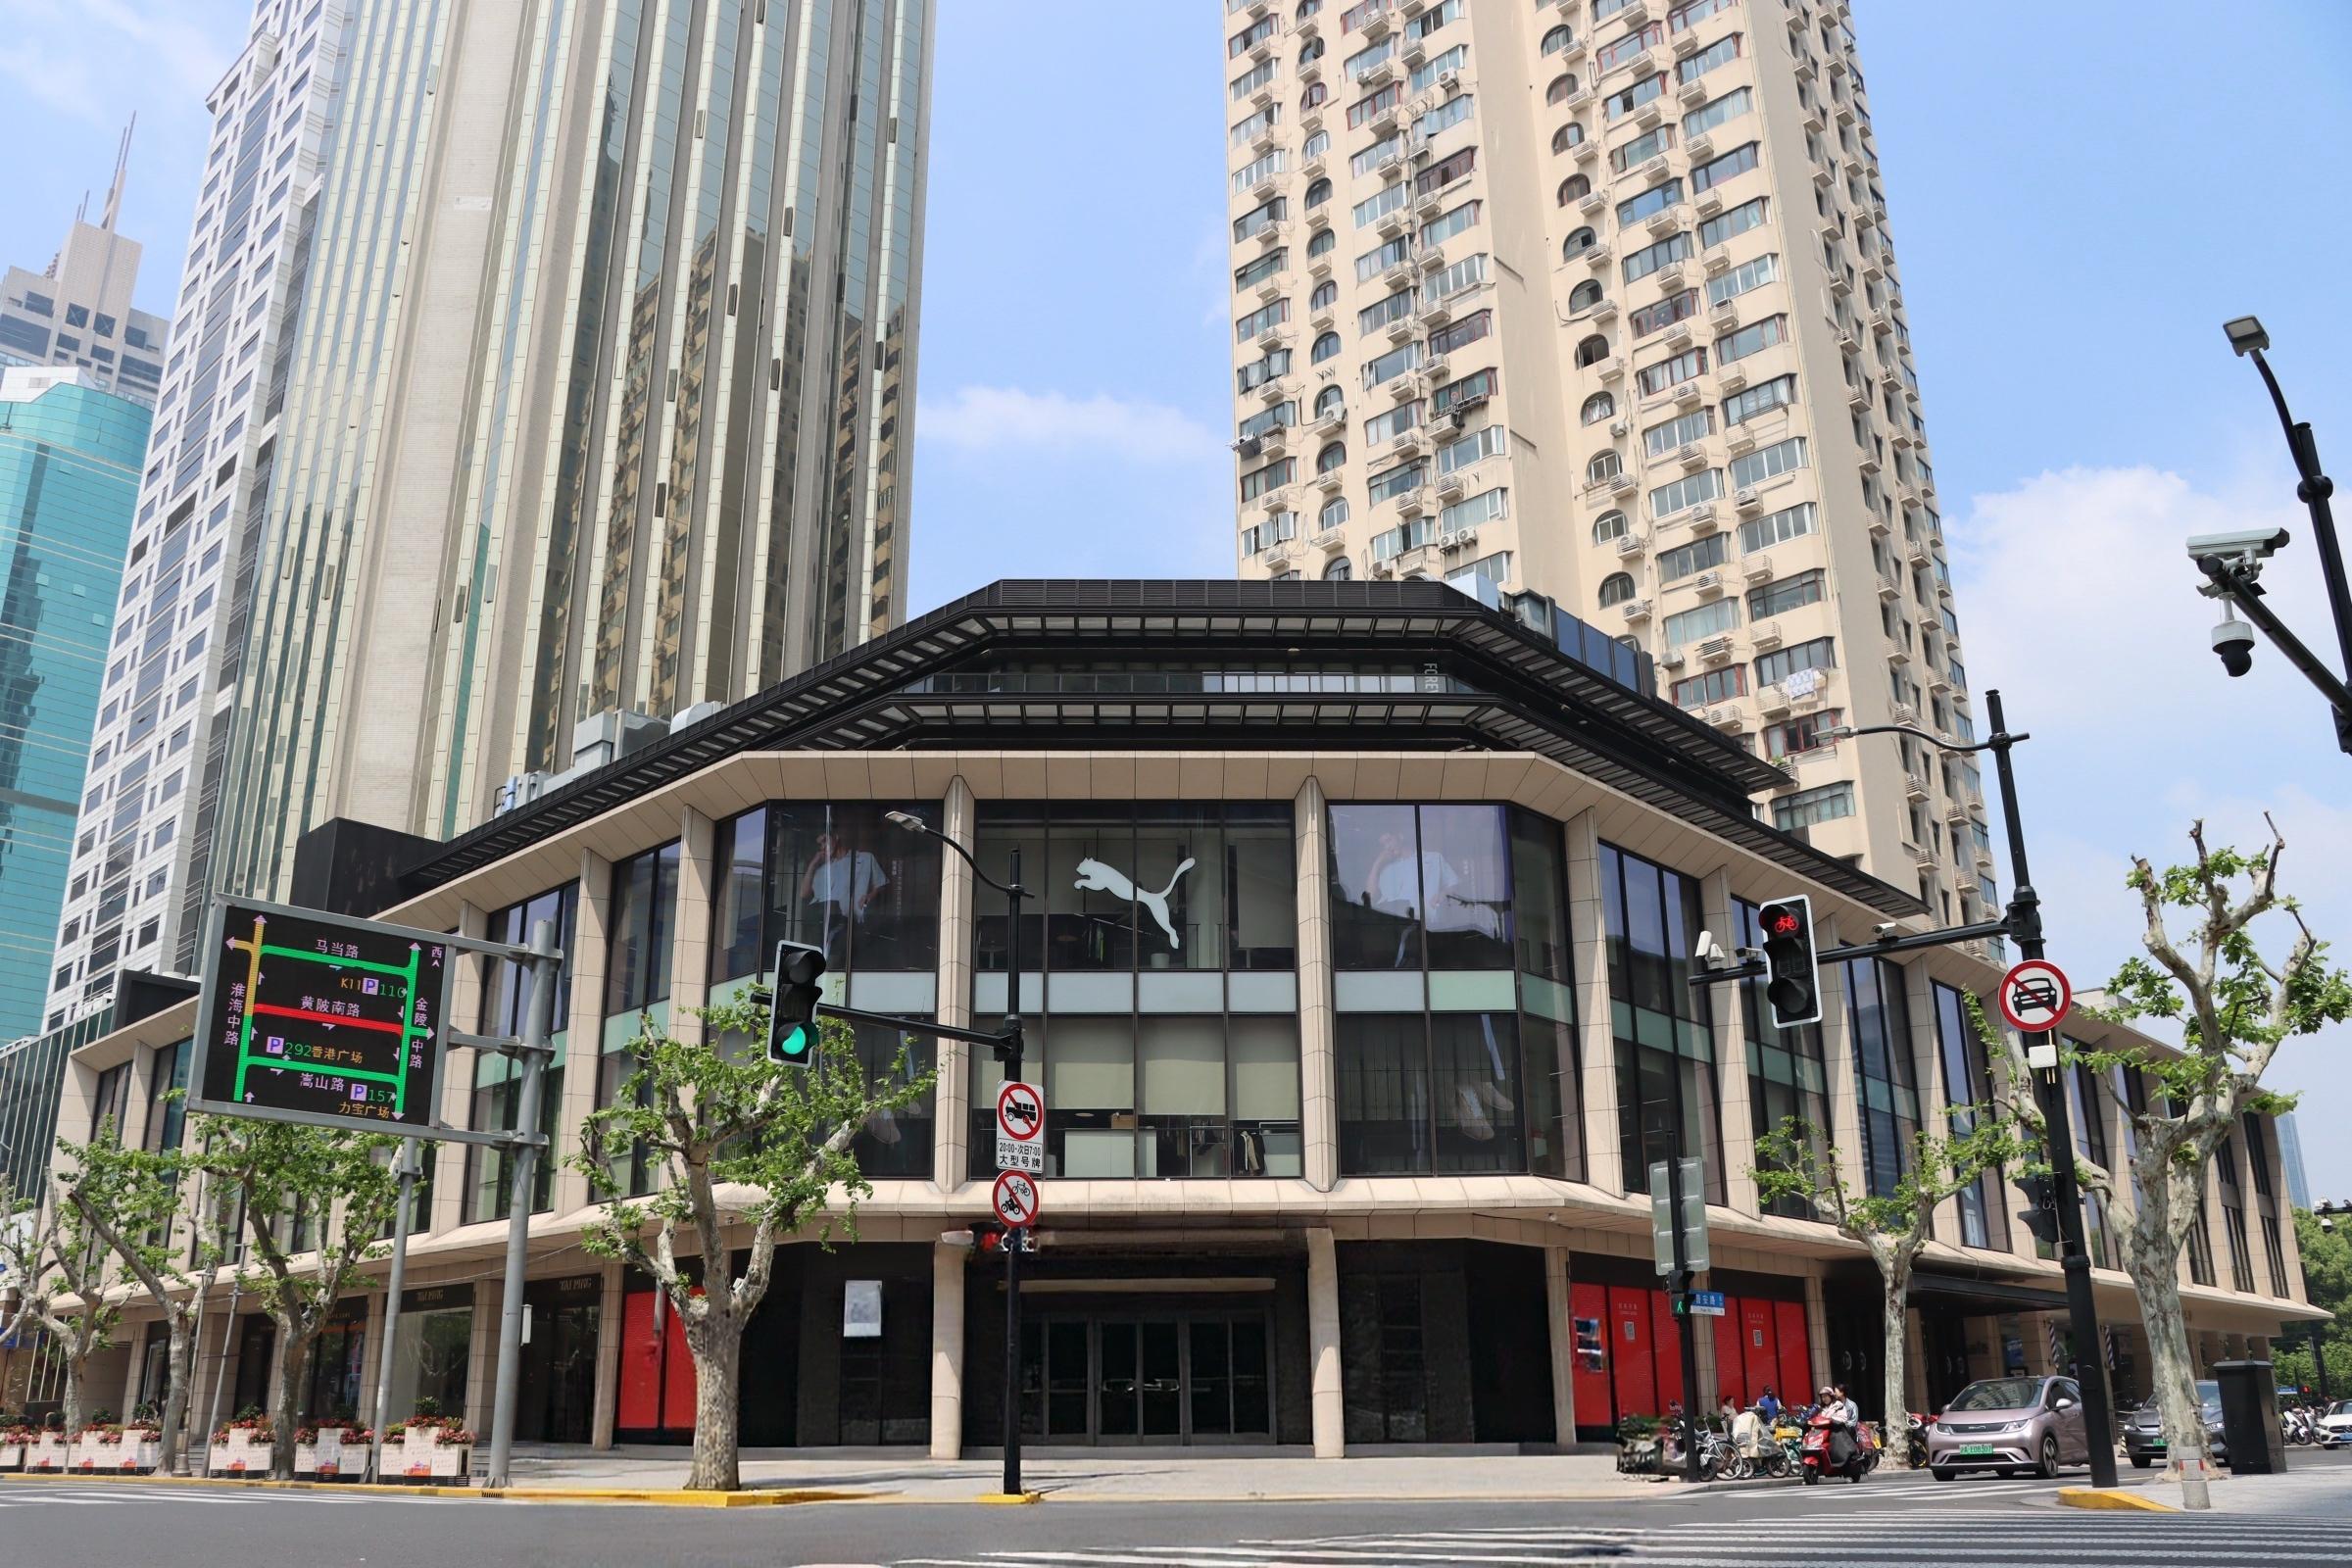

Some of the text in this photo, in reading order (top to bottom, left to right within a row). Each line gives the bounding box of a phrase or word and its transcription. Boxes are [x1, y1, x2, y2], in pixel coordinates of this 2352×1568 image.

[316, 939, 359, 958] 马当路
[431, 946, 442, 958] 西
[340, 978, 361, 991] K11
[223, 982, 246, 1046] 淮海中路
[300, 995, 361, 1017] 黄陂南路
[409, 997, 428, 1069] 金陵中路
[284, 1042, 312, 1056] 292
[312, 1046, 363, 1063] 香港广场
[300, 1072, 345, 1092] 嵩山路
[368, 1089, 394, 1102] 157
[338, 1102, 390, 1118] 力宝广场
[999, 1153, 1041, 1168] 大型号牌
